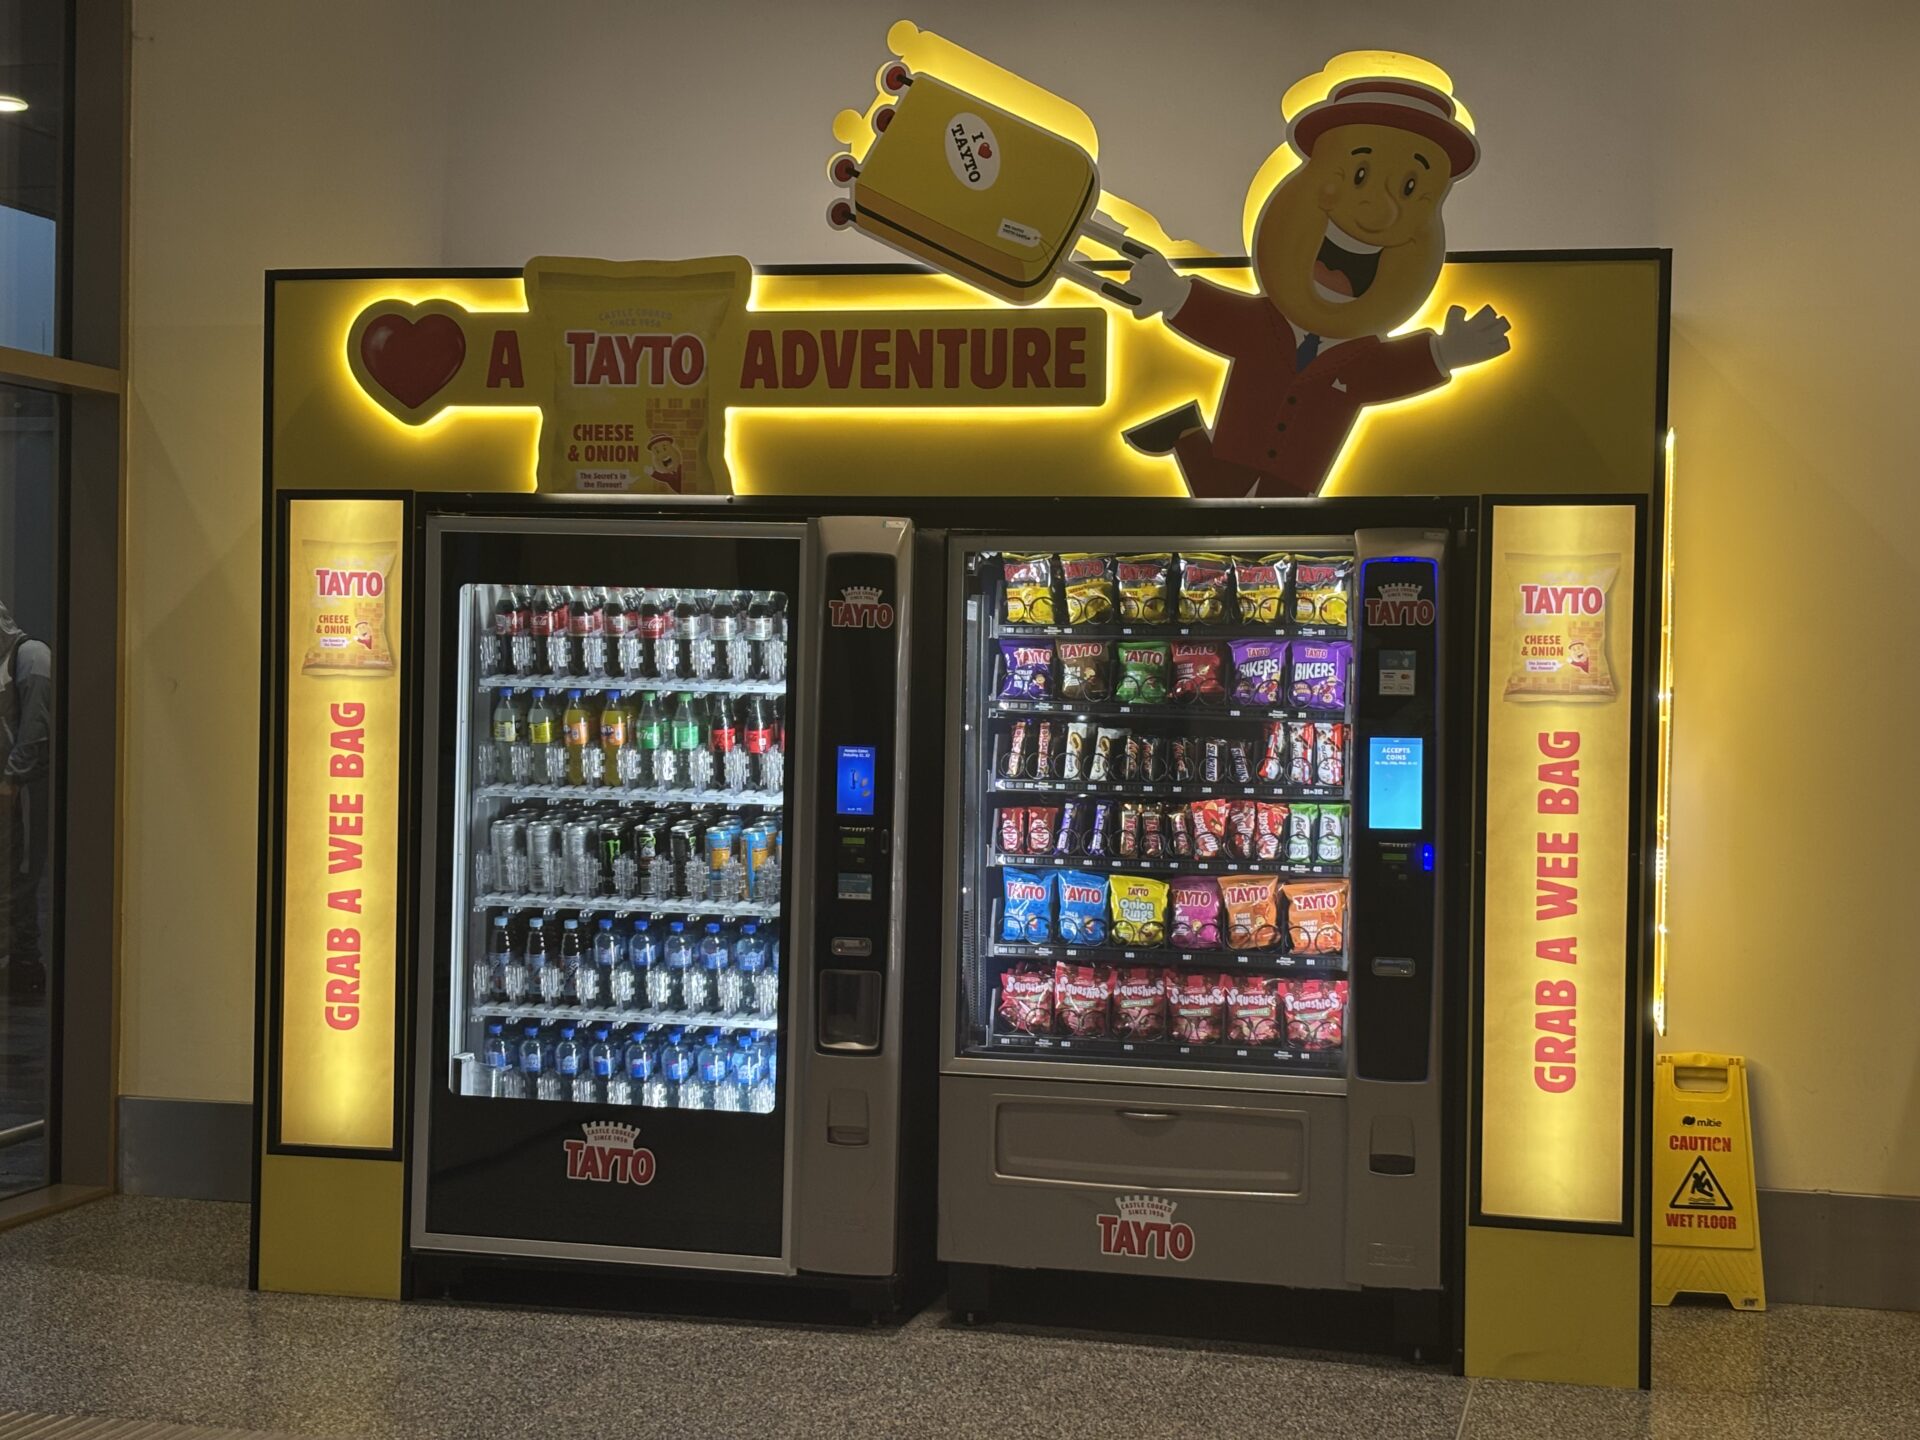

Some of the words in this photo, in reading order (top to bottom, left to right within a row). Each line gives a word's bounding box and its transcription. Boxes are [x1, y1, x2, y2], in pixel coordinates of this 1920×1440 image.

[971, 131, 985, 143] I
[950, 123, 981, 183] TAYTO
[486, 330, 525, 388] A
[565, 331, 706, 388] TAYTO
[739, 327, 1087, 389] ADVENTURE
[572, 424, 634, 442] CHEESE
[567, 445, 579, 462] &
[584, 445, 639, 462] ONION
[315, 568, 384, 597] TAYTO
[1520, 584, 1604, 615] TAYTO
[318, 614, 349, 624] CHEESE
[828, 600, 894, 629] TAYTO
[1364, 598, 1435, 626] TAYTO
[315, 624, 323, 634] &
[324, 624, 352, 635] ONION
[1524, 635, 1561, 645] CHEESE
[1014, 648, 1052, 667] TAYTO
[1061, 643, 1102, 659] TAYTO
[1124, 650, 1164, 665] TAYTO
[1247, 647, 1270, 658] TAYTO
[1305, 647, 1328, 659] TAYTO
[1520, 646, 1529, 656] &
[1531, 646, 1564, 657] ONION
[1239, 658, 1279, 679] BIKERS
[1295, 662, 1335, 681] BIKERS
[329, 702, 366, 778] BAG
[1206, 743, 1217, 781] SNICKERS
[1291, 742, 1302, 769] bueno
[1319, 744, 1330, 770] bueno
[1537, 731, 1581, 815] BAG
[328, 793, 364, 875] WEE
[1536, 832, 1579, 921] WEE
[1006, 881, 1047, 900] TAYTO
[1063, 884, 1102, 903] TAYTO
[1127, 887, 1149, 896] TAYTO
[1173, 890, 1212, 907] TAYTO
[1227, 886, 1271, 905] TAYTO
[327, 888, 362, 915] A
[1119, 899, 1155, 911] Onion
[1293, 894, 1338, 911] TAYTO
[1122, 909, 1153, 923] Rings
[1535, 936, 1577, 965] A
[324, 927, 361, 1031] GRAB
[1533, 979, 1577, 1093] GRAB
[587, 1128, 609, 1136] CASTLE
[1697, 1118, 1722, 1128] mitie
[1669, 1134, 1732, 1153] CAUTION
[564, 1140, 656, 1185] TAYTO
[1121, 1202, 1145, 1210] CASTLE
[1146, 1202, 1172, 1213] COOKED
[1666, 1213, 1694, 1229] WET
[1697, 1214, 1737, 1230] FLOOR
[1097, 1214, 1195, 1261] TAYTO
